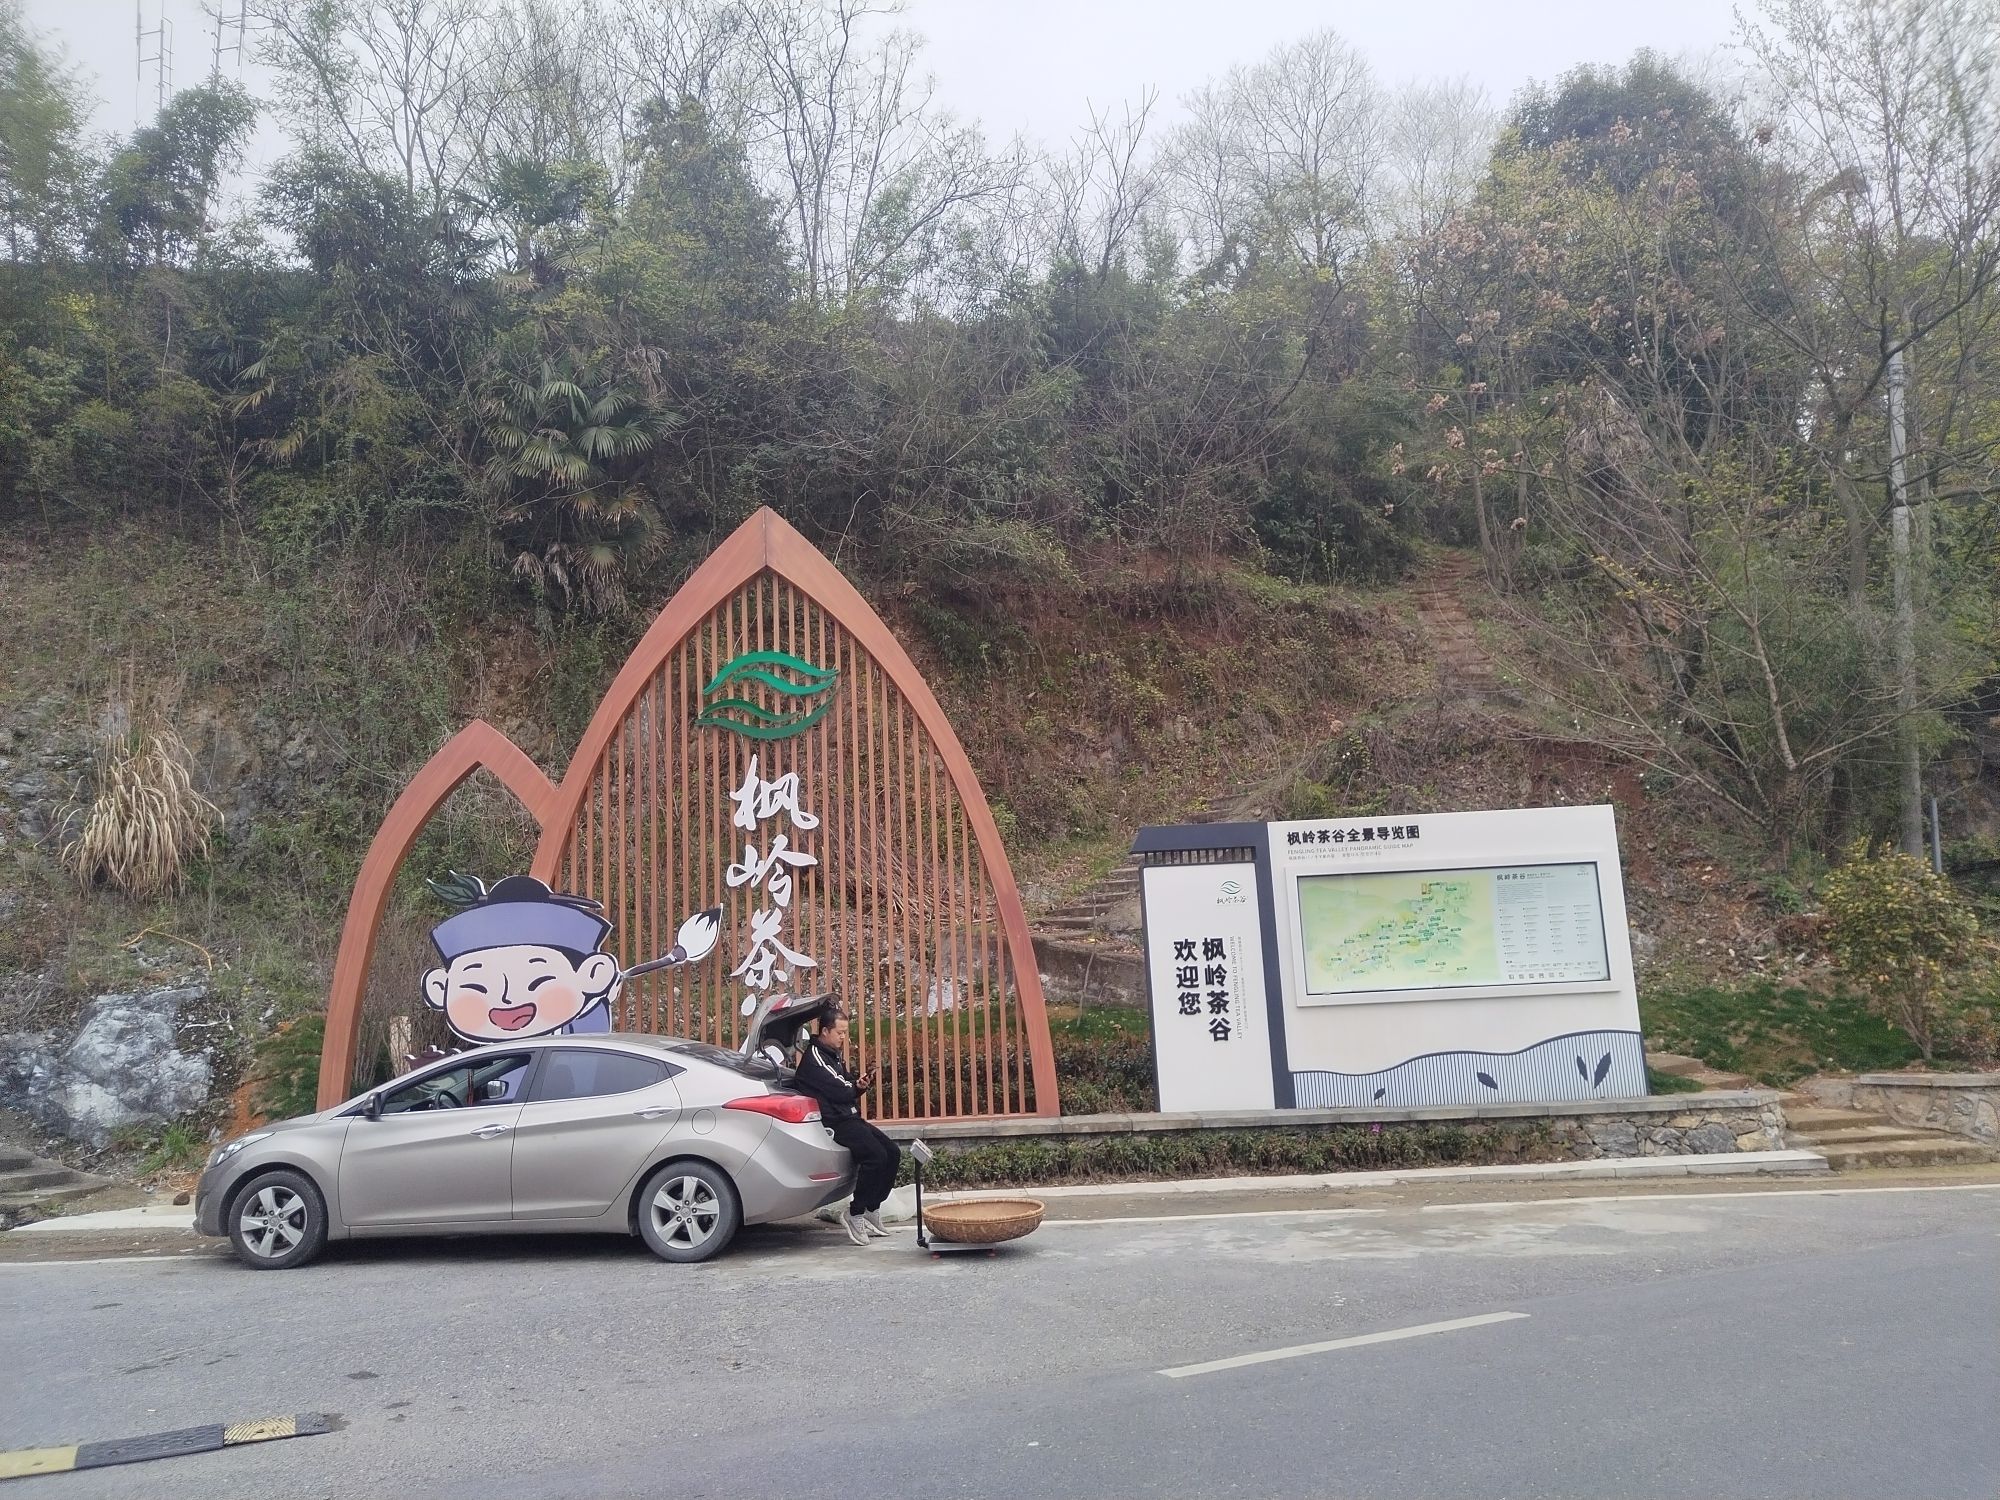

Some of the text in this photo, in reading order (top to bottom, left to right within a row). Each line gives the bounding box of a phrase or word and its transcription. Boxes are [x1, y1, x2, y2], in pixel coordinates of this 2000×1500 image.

[1287, 825, 1420, 846] 枫岭茶谷全景导览图
[1496, 872, 1526, 881] 枫岭茶谷
[1173, 938, 1201, 1016] 欢迎您
[1233, 966, 1238, 974] TO
[1202, 937, 1232, 1042] 枫岭茶谷
